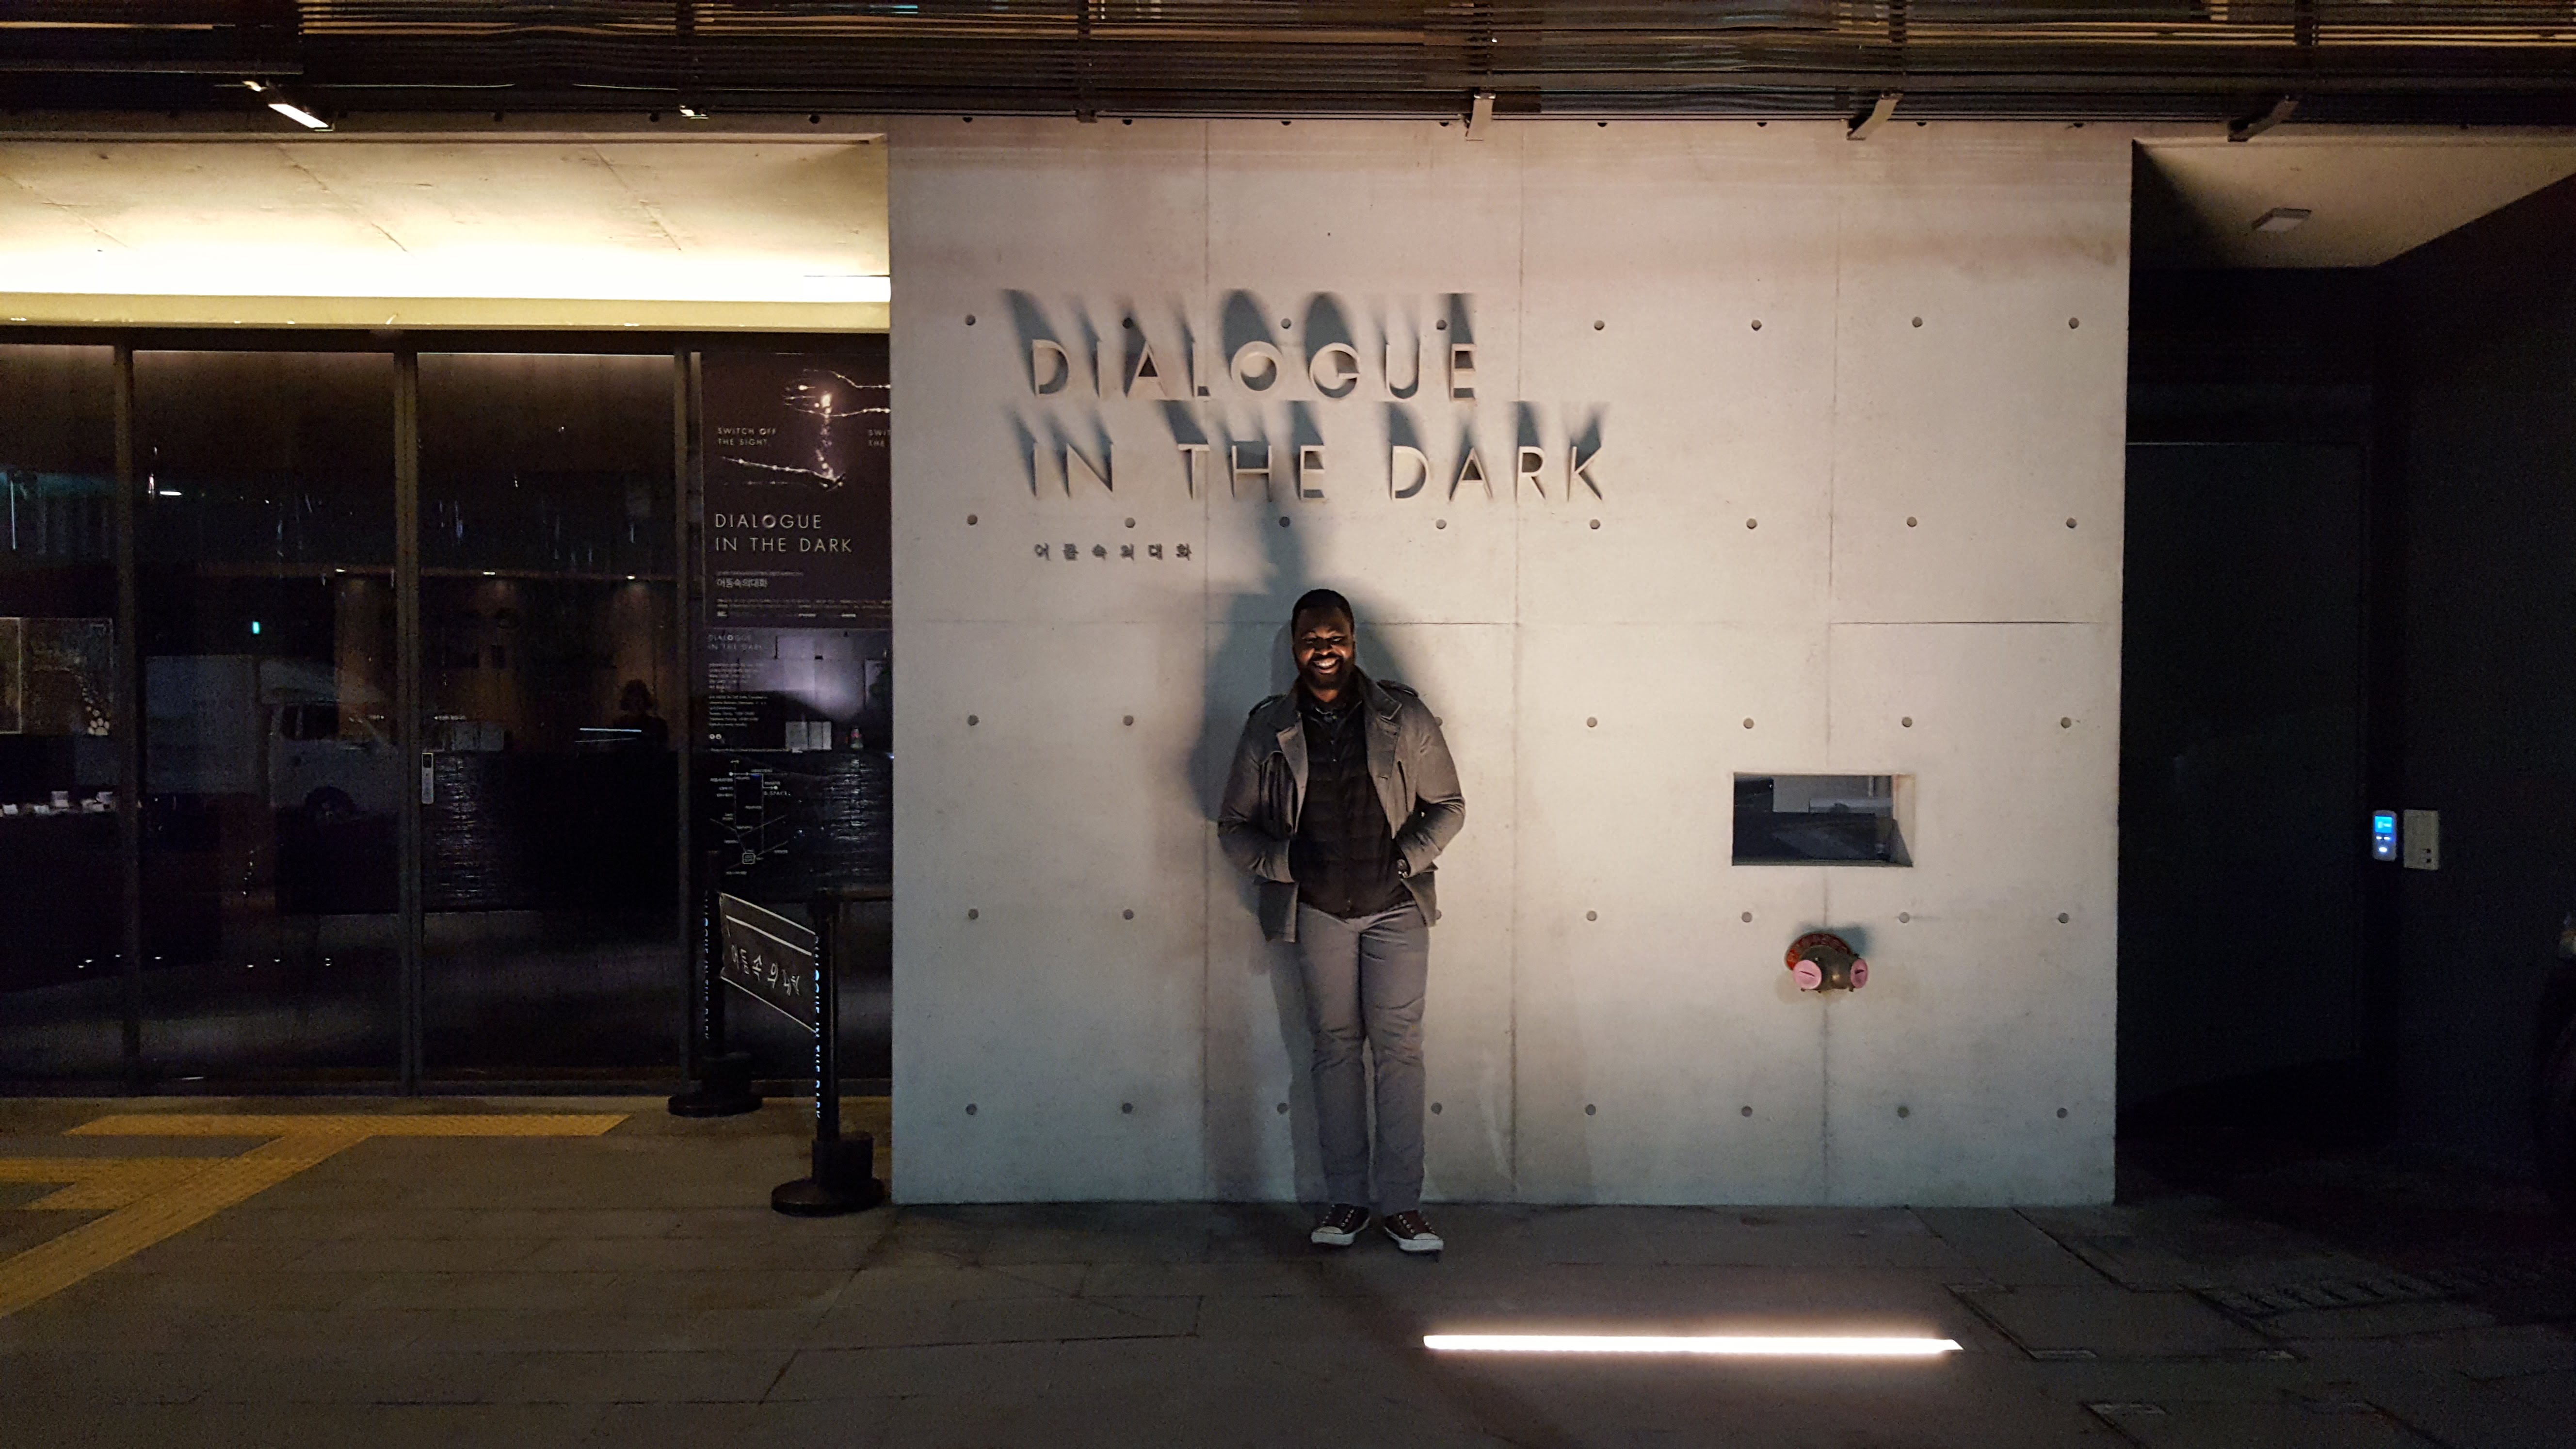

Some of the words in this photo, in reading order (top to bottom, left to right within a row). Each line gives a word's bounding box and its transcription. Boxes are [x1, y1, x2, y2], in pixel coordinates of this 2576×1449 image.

[1031, 338, 1477, 401] DIALOGUE
[717, 427, 755, 435] SWITCH
[759, 428, 776, 436] OFF
[1032, 442, 1115, 500] IN
[1176, 442, 1327, 501] THE
[1390, 444, 1604, 502] DARK
[715, 514, 822, 529] DIALOGUE
[715, 537, 737, 551] IN
[750, 537, 787, 552] THE
[800, 538, 852, 552] DARK
